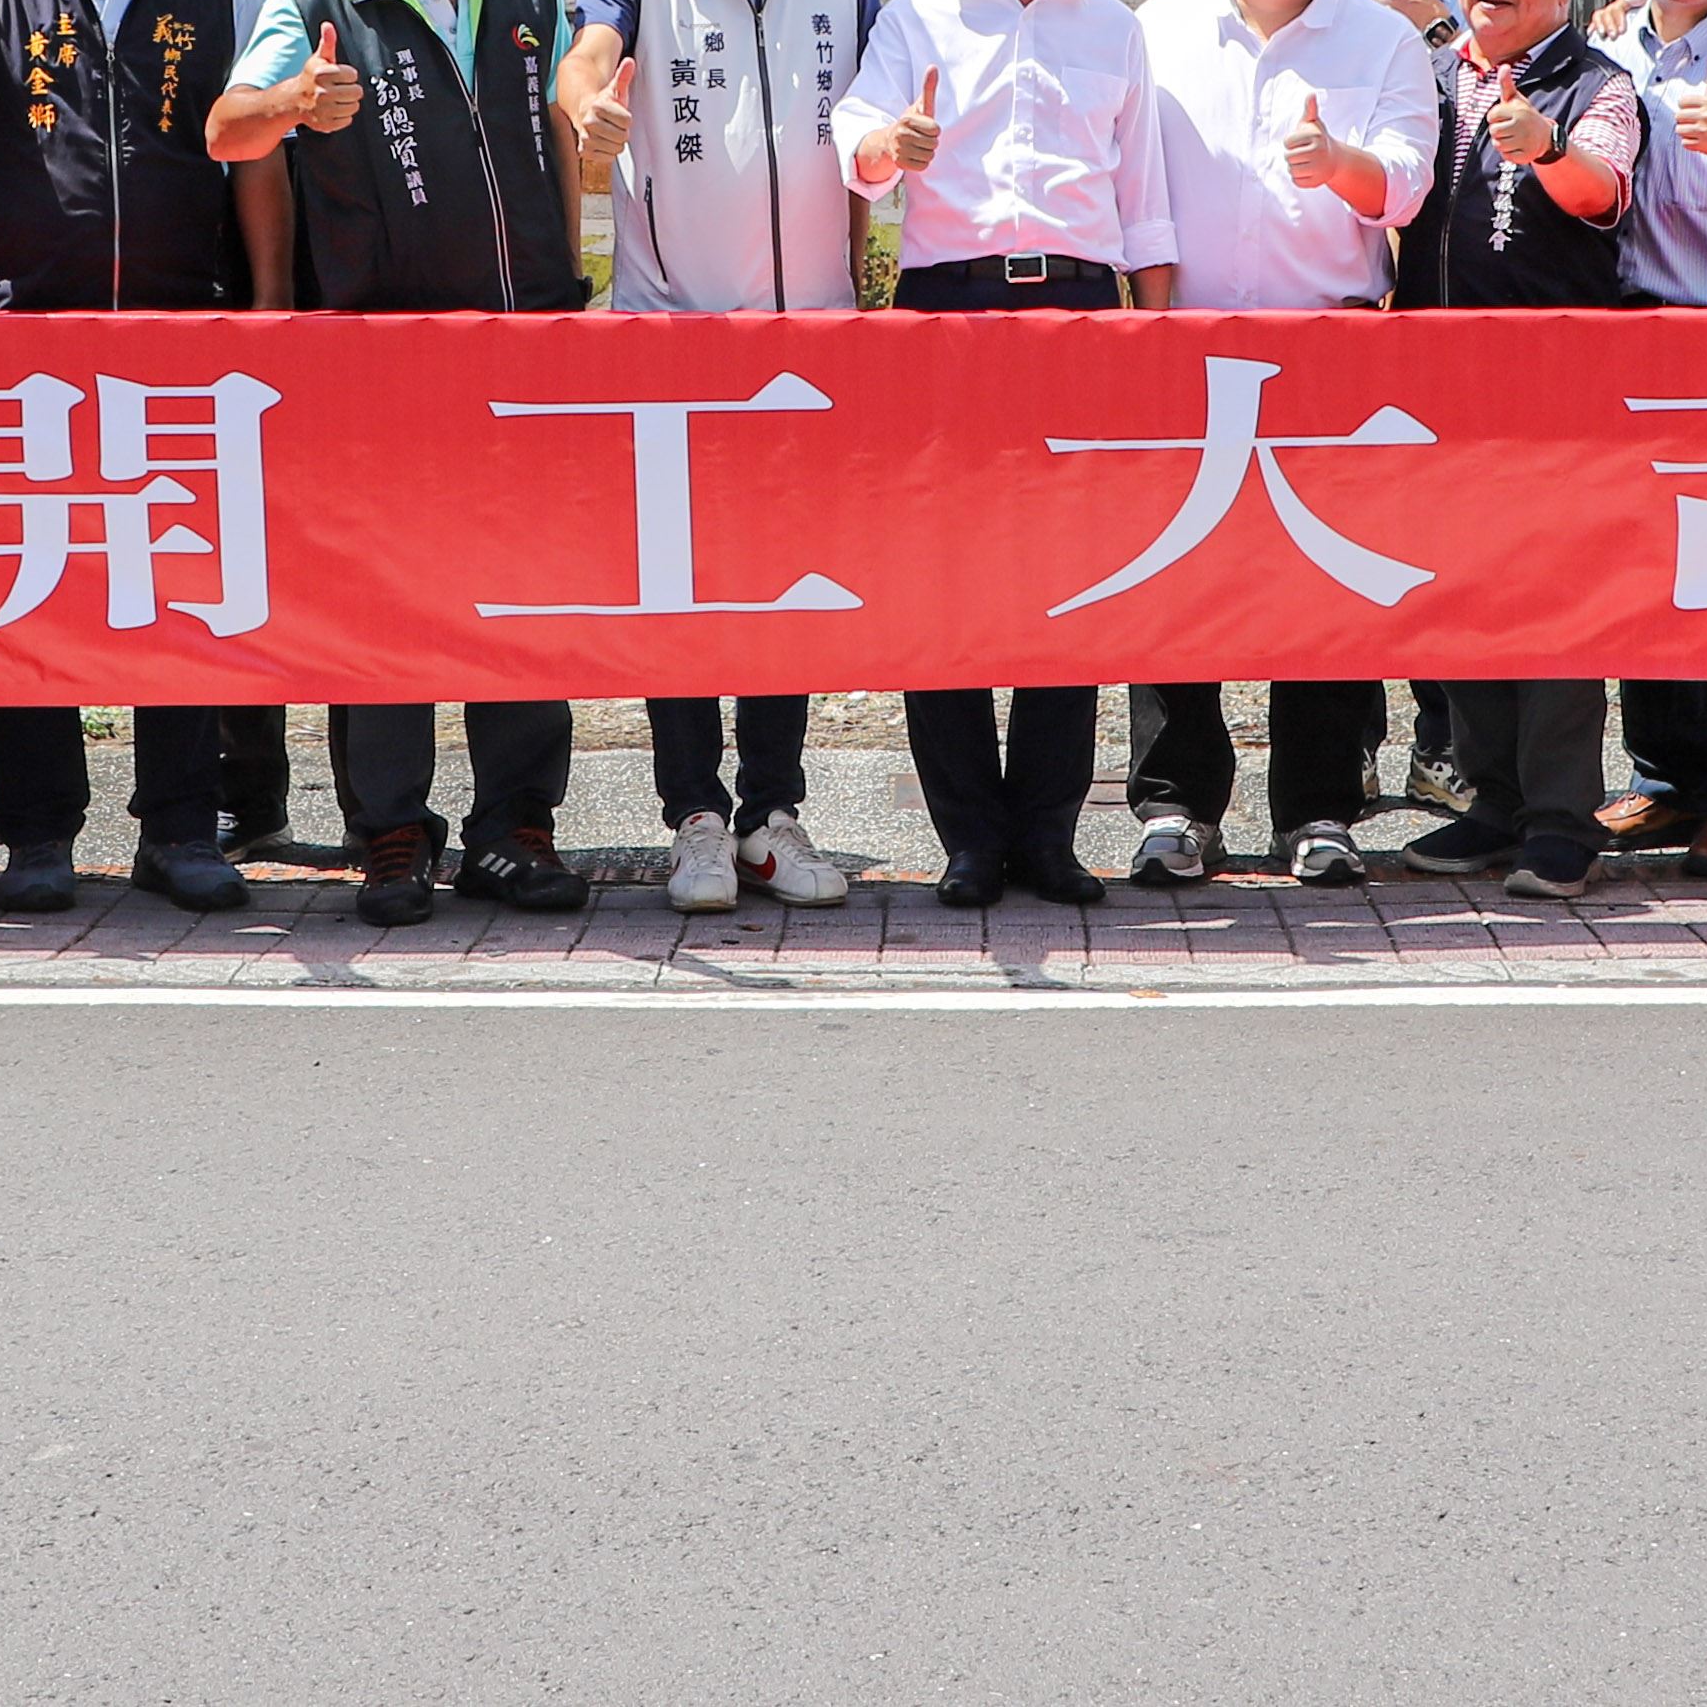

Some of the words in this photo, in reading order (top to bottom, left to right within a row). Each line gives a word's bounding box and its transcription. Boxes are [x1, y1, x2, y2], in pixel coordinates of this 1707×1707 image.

[55, 12, 78, 68] 主席
[396, 48, 425, 102] 理事長
[704, 32, 726, 89] 鄉長
[811, 14, 834, 145] 義竹鄉公所
[24, 31, 56, 133] 黃金獅
[670, 59, 703, 163] 黃政傑
